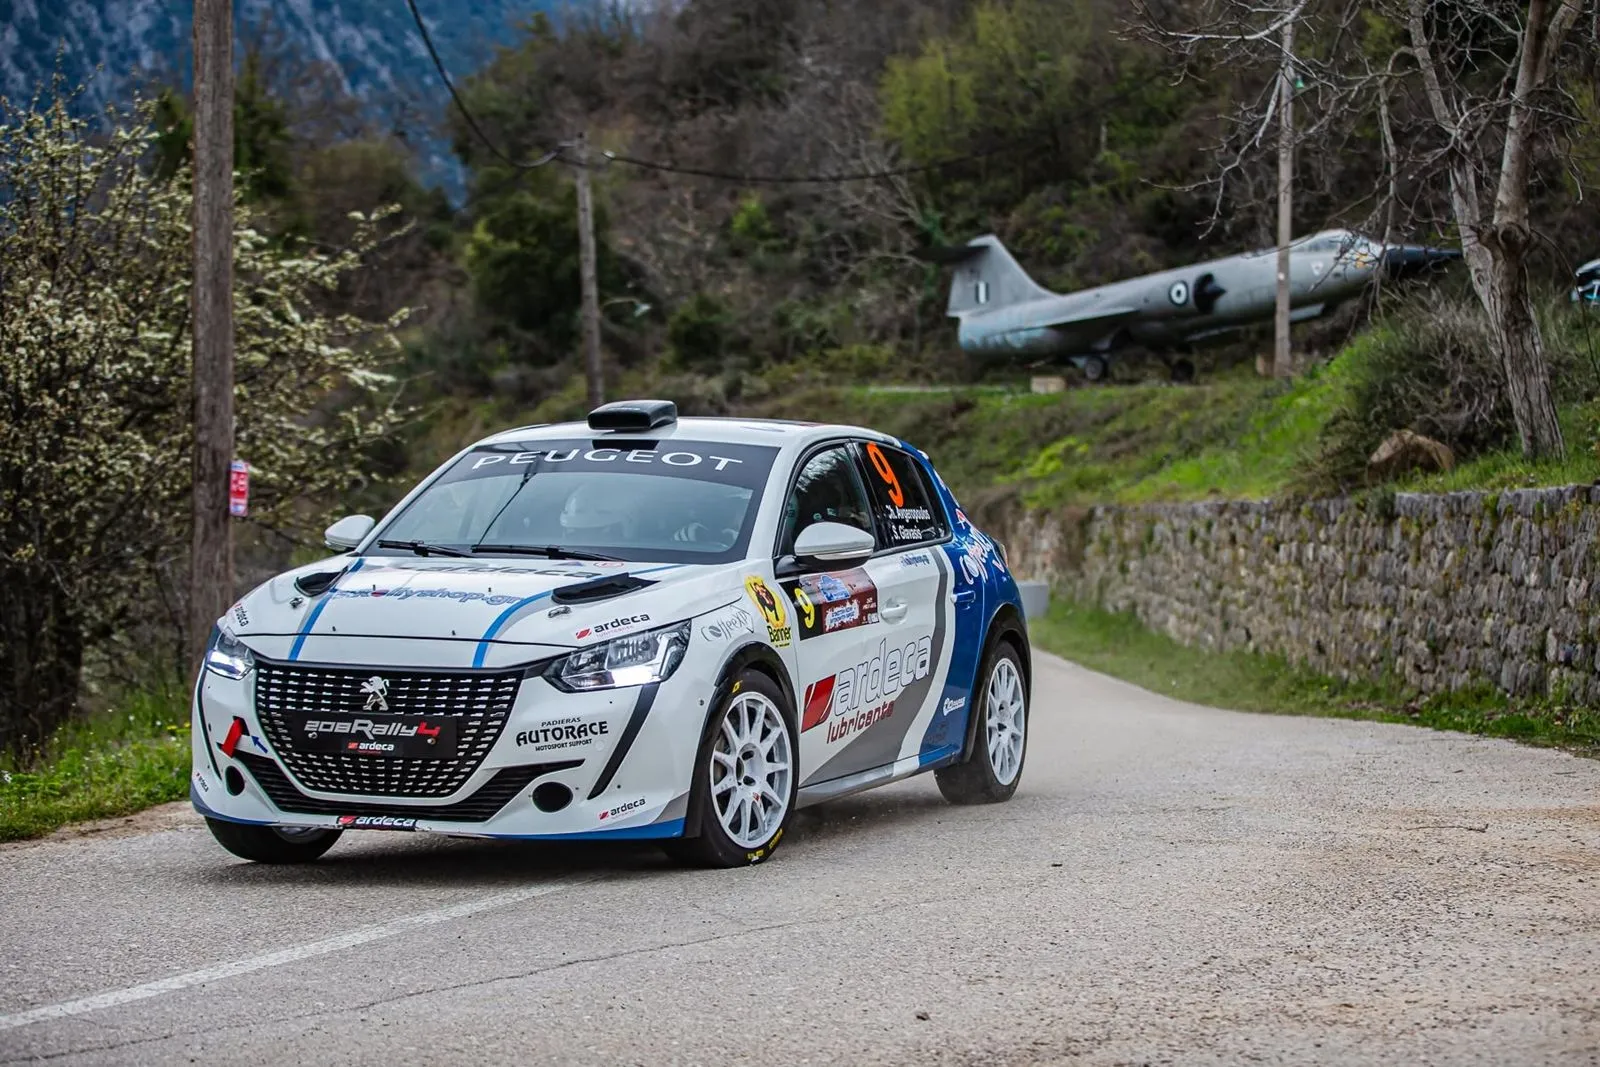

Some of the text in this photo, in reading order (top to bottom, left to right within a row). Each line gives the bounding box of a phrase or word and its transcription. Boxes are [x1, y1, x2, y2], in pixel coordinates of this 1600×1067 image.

[472, 448, 743, 472] PEUGEOT
[866, 441, 904, 508] 9
[794, 588, 815, 629] 9
[594, 614, 650, 633] ardeca
[767, 625, 791, 643] Banner
[834, 635, 932, 717] ardeca
[541, 717, 581, 727] PADIERAS
[516, 721, 609, 747] AUTORACE
[568, 738, 592, 748] SUPPORT
[359, 741, 395, 751] ardeca
[610, 798, 646, 816] ardeca
[355, 815, 417, 827] ardeca
